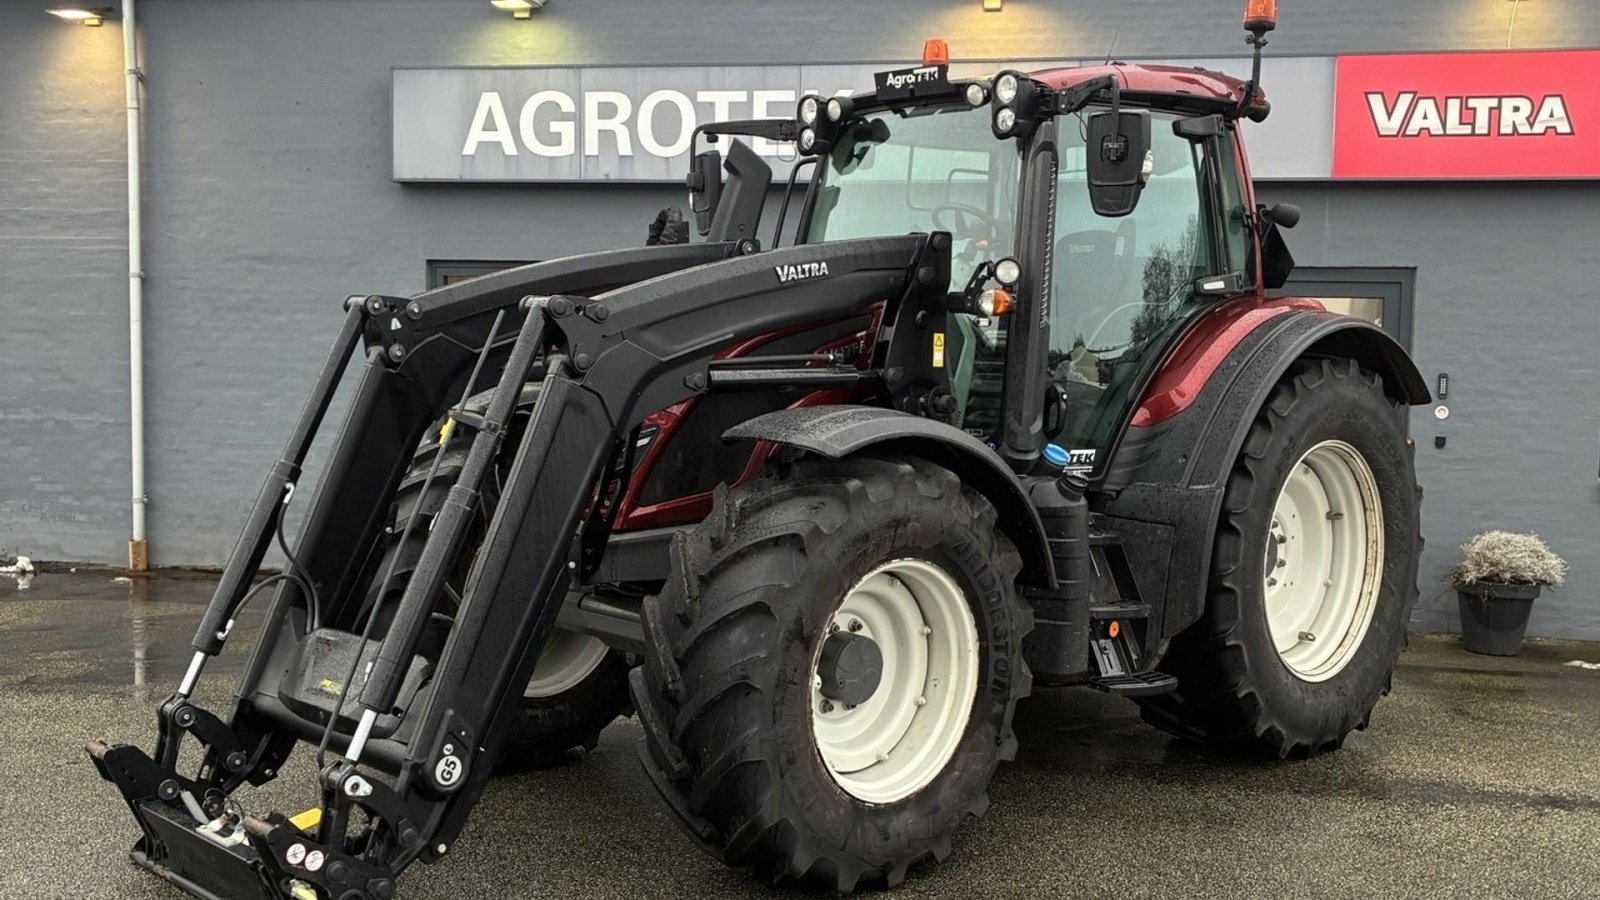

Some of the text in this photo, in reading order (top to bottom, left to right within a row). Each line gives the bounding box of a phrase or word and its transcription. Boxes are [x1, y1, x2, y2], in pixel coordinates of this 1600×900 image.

[461, 89, 854, 158] AGROTE
[1364, 91, 1575, 137] VALTRA
[775, 261, 829, 283] VALTRA
[440, 758, 457, 782] G5
